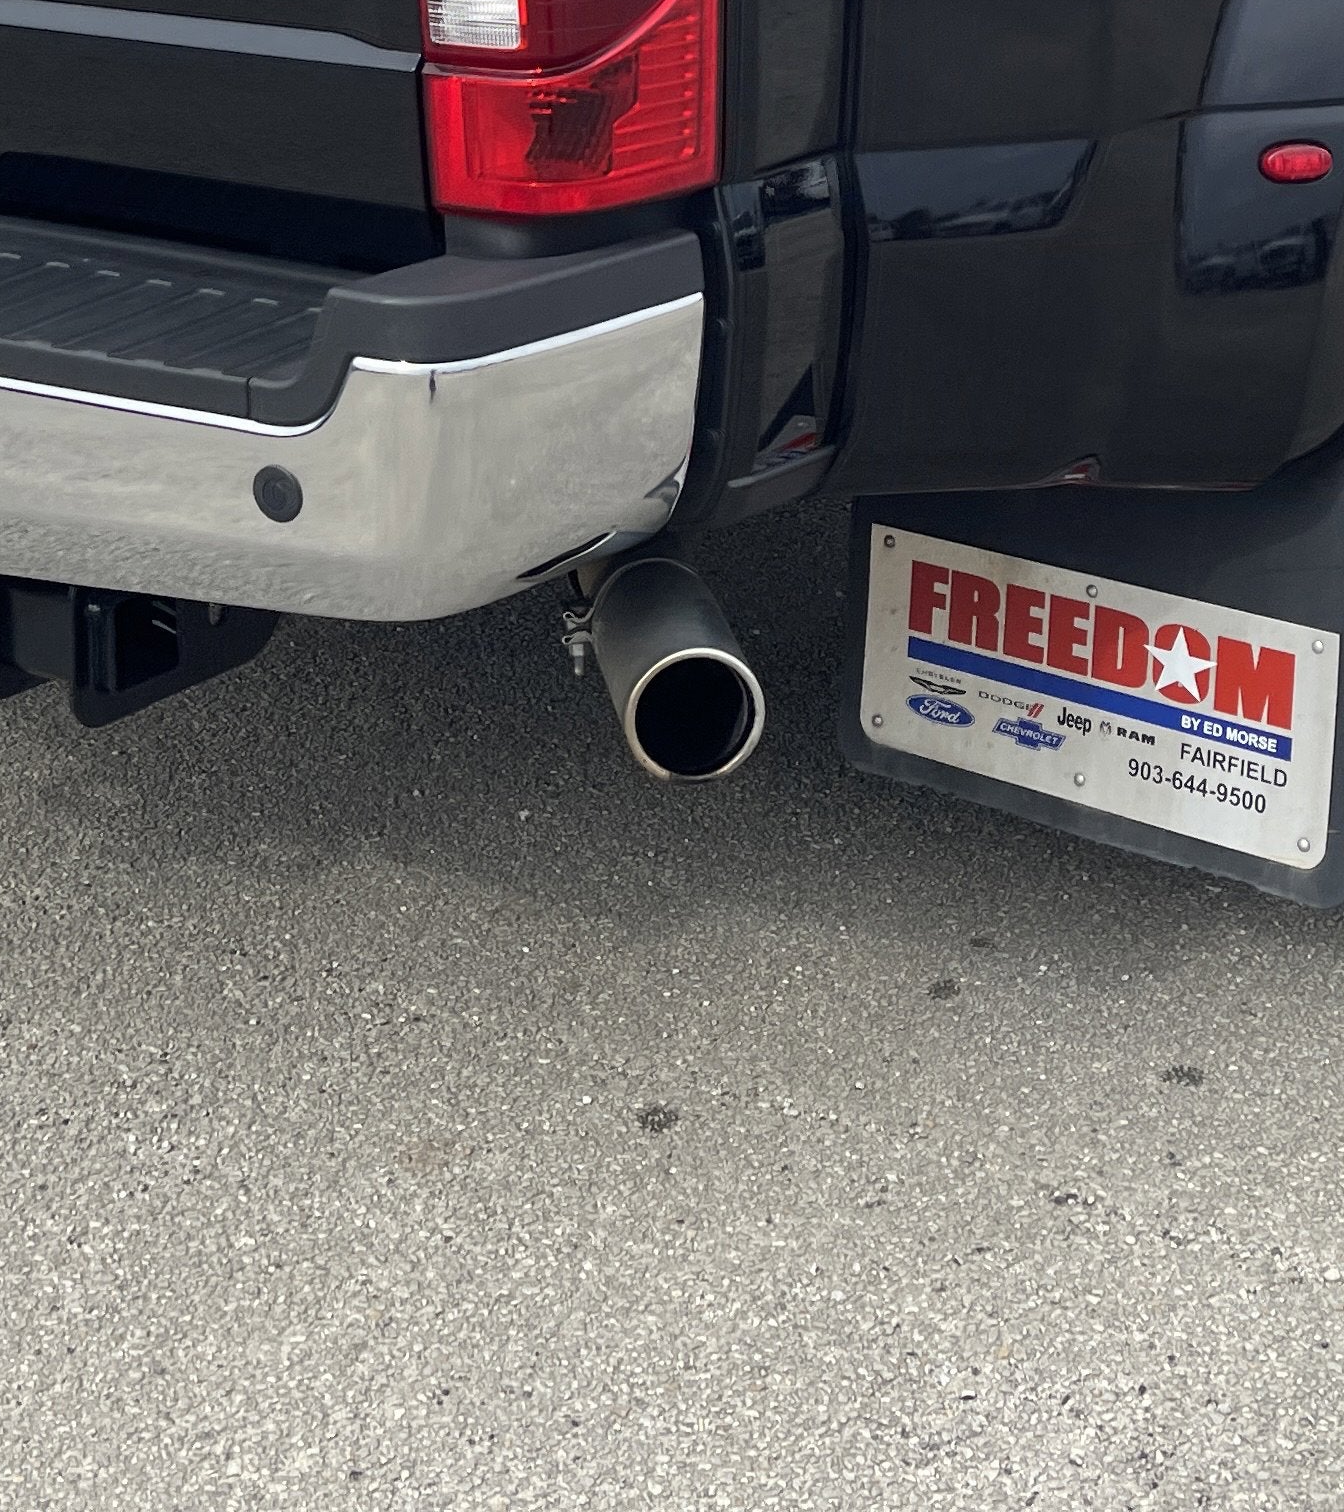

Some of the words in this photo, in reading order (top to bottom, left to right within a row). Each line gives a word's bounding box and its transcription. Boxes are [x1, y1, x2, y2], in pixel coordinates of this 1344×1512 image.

[908, 559, 1296, 731] FREEDOM
[919, 698, 961, 724] Ford
[1057, 706, 1092, 736] Jeep
[999, 722, 1059, 745] CHEVROLET
[1117, 726, 1156, 746] RAM
[1181, 715, 1202, 731] BY
[1203, 720, 1223, 738] ED
[1226, 726, 1278, 753] MORSE
[1180, 742, 1288, 788] FAIRFIELD
[1128, 758, 1267, 814] 903-644-9500
